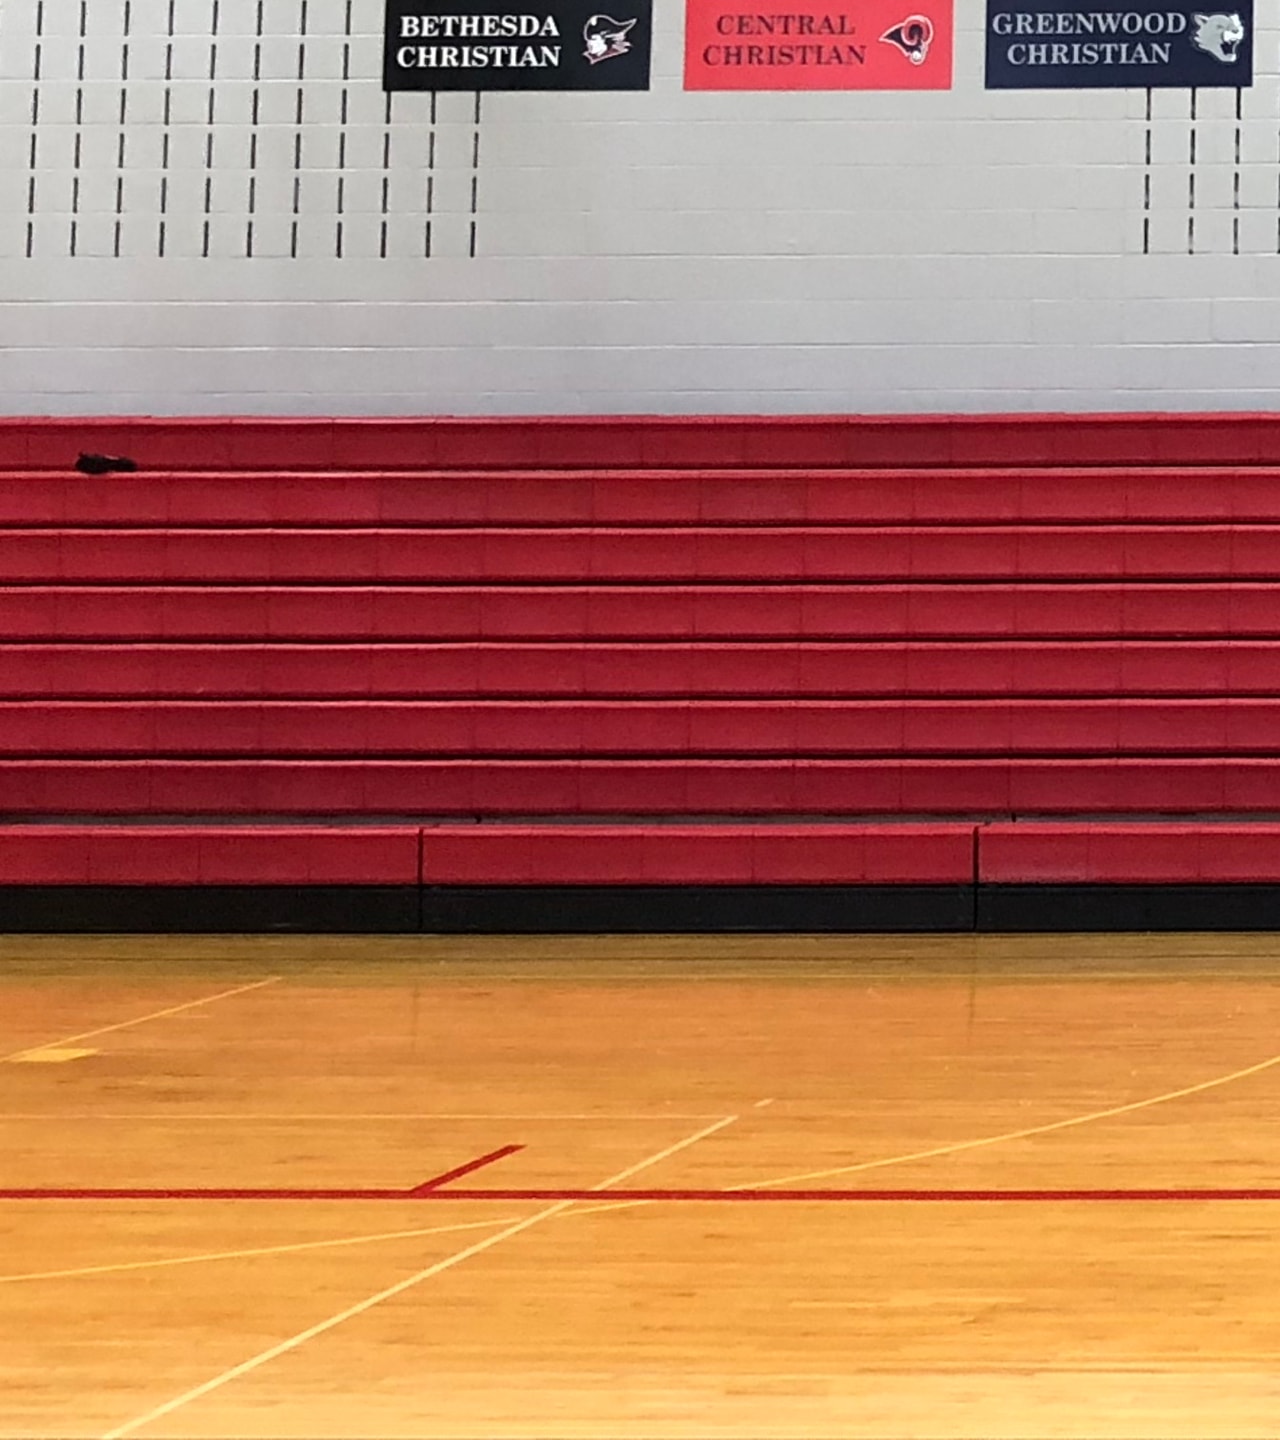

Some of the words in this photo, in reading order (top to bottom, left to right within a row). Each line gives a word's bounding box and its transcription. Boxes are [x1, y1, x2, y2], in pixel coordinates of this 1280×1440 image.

[401, 15, 560, 38] BETHESDA
[716, 14, 855, 36] CENTRAL
[993, 12, 1186, 35] GREENWOOD
[397, 45, 561, 68] CHRISTIAN
[703, 44, 866, 66] CHRISTIAN
[1007, 43, 1171, 65] CHRISTIAN
